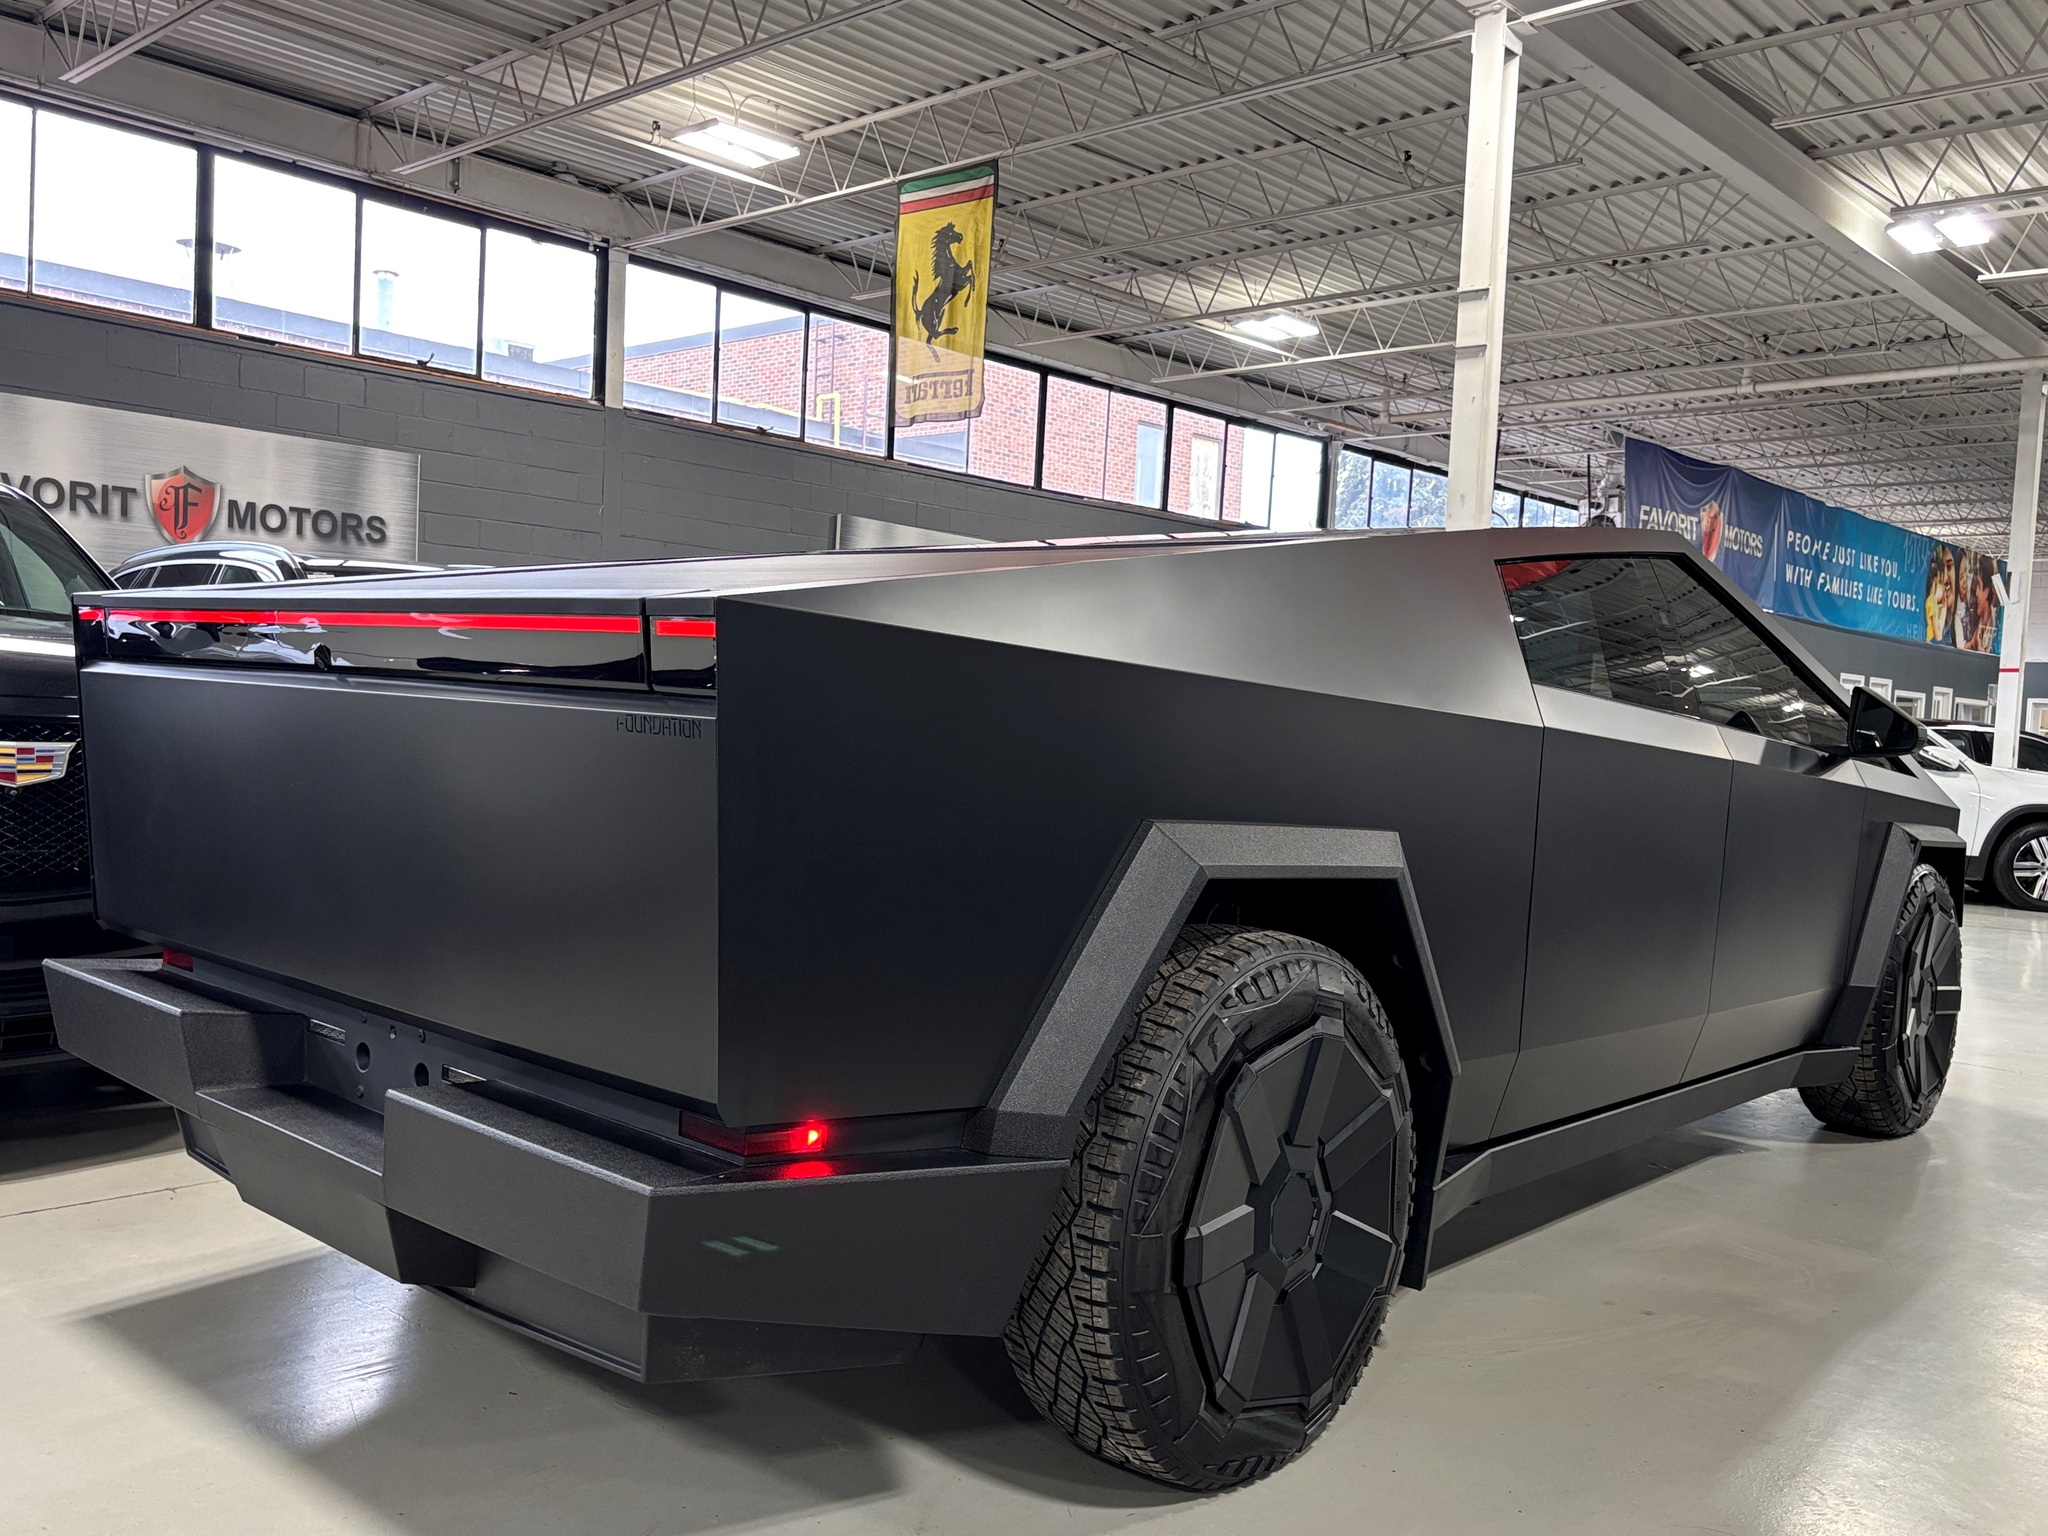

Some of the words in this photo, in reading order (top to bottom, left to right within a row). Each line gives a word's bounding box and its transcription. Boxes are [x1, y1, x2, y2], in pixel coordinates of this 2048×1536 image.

[227, 499, 387, 543] MOTORS
[1638, 504, 1699, 541] FAVORIT
[1724, 523, 1763, 558] MOTORS
[1832, 544, 1856, 568] JUST
[1859, 551, 1879, 574] LIKE
[1785, 563, 1813, 589] WITH
[1816, 572, 1864, 601] FAMILIES
[1866, 584, 1883, 605] LIKE
[1887, 589, 1920, 613] YOURS.
[616, 713, 702, 739] FOUNDATION
